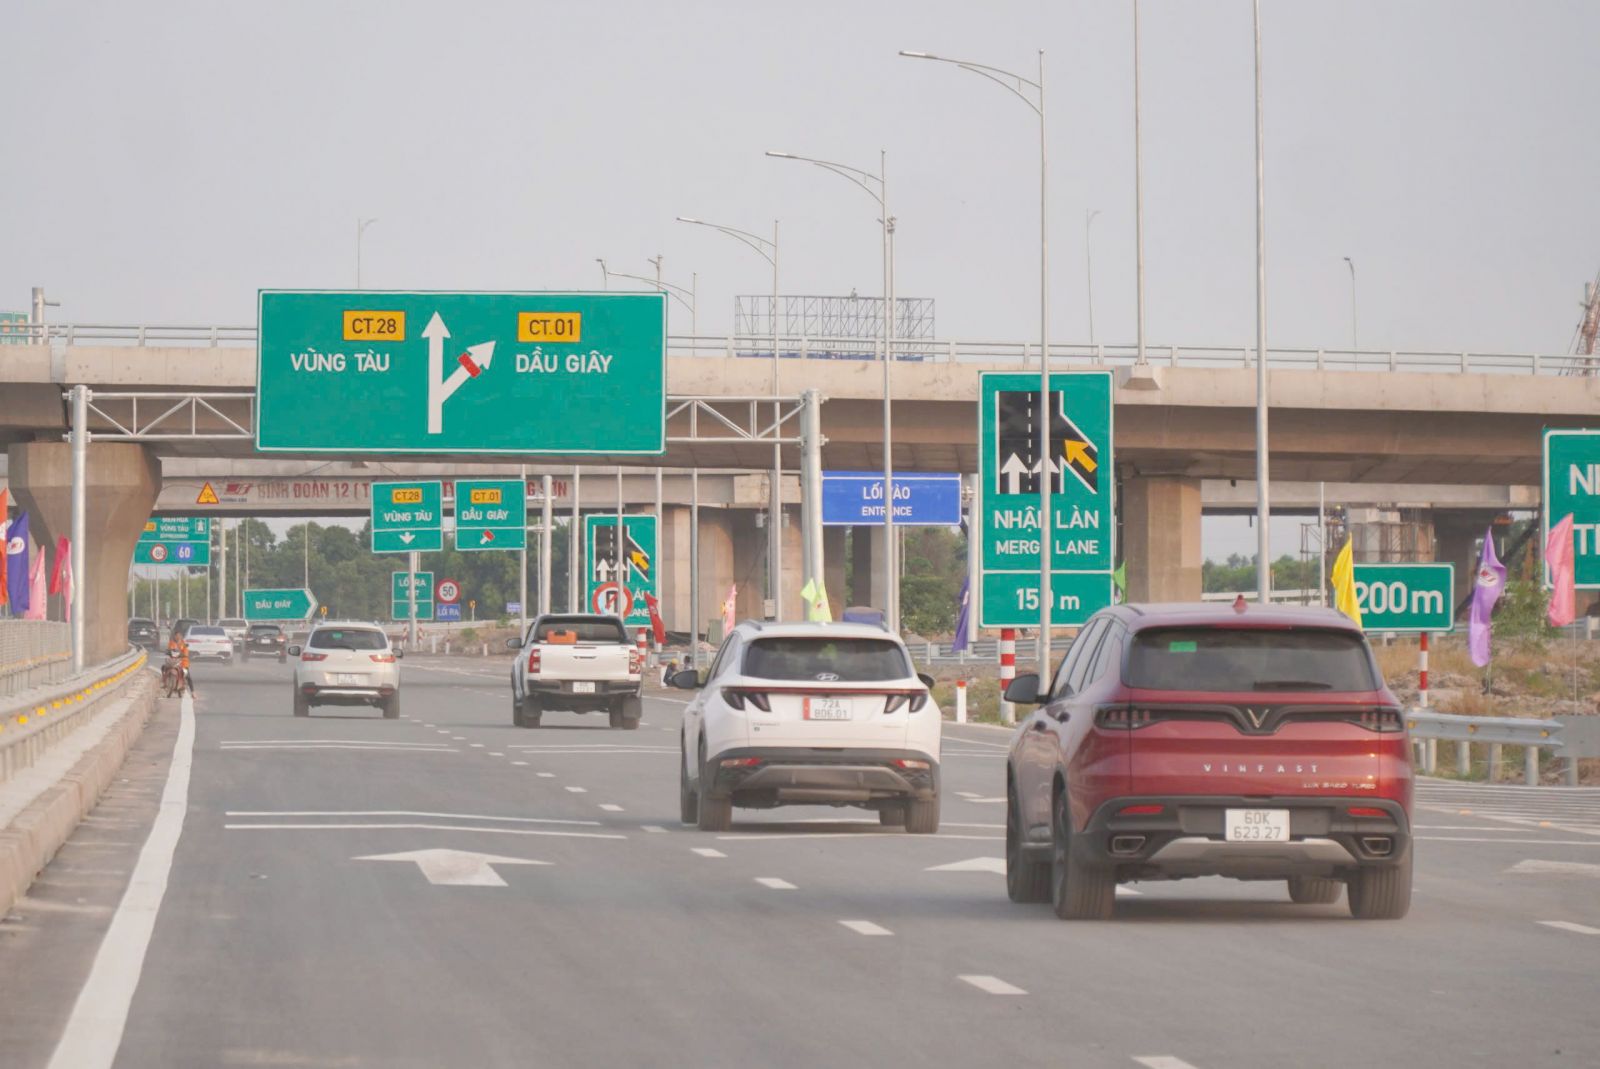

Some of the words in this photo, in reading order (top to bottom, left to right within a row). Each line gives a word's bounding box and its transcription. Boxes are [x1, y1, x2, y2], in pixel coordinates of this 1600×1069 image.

[352, 318, 397, 334] CT.28
[529, 318, 574, 336] CT.01
[290, 347, 346, 372] VŨNG
[354, 348, 390, 372] TÀU
[515, 346, 558, 373] DẦU
[565, 350, 613, 373] GIÂY
[334, 483, 349, 498] 12
[394, 491, 420, 501] CT.28
[473, 491, 499, 501] CT.01
[863, 481, 883, 500] LỐI
[891, 483, 911, 500] ÀO
[862, 505, 913, 517] ENTRNCE
[1056, 505, 1099, 529] LÀN
[179, 546, 191, 559] 60
[996, 540, 1041, 555] MERG
[1055, 540, 1099, 555] LANE
[442, 586, 454, 597] 50
[1016, 588, 1054, 610] 15
[1060, 595, 1080, 610] m
[1355, 581, 1407, 614] 200
[1411, 590, 1443, 614] m
[1203, 764, 1318, 773] VINFAST
[1244, 811, 1270, 825] 60K
[1234, 826, 1281, 839] 623.27
